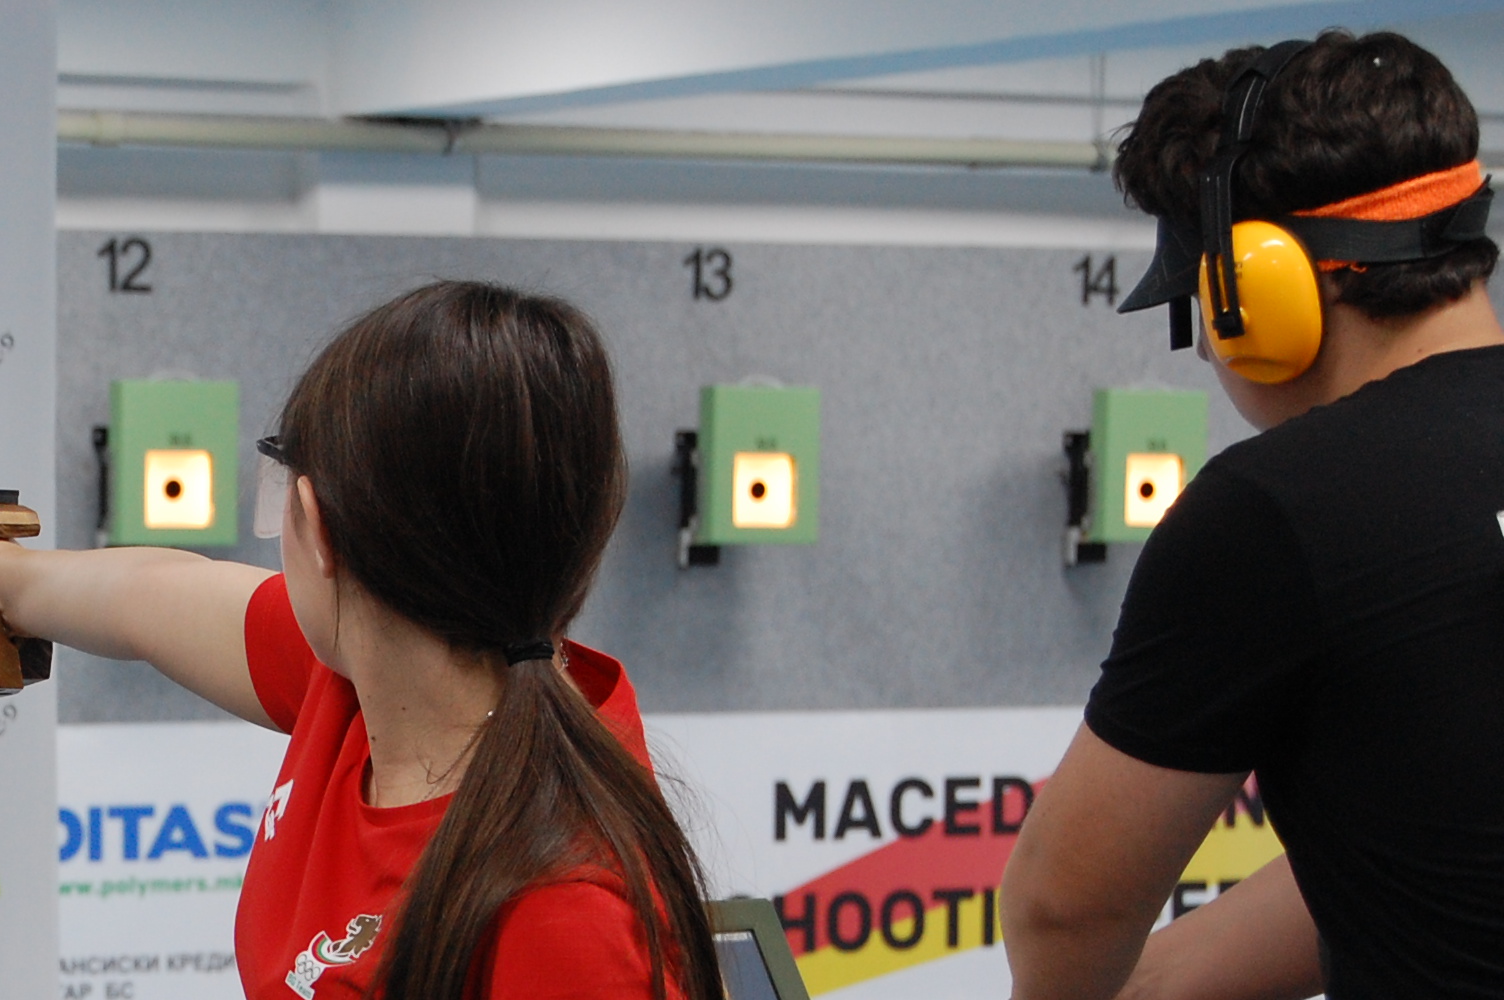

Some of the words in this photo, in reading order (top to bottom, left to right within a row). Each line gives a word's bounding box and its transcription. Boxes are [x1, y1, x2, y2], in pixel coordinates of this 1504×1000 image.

[98, 238, 152, 293] 12
[682, 249, 733, 301] 13
[1073, 256, 1119, 305] 14
